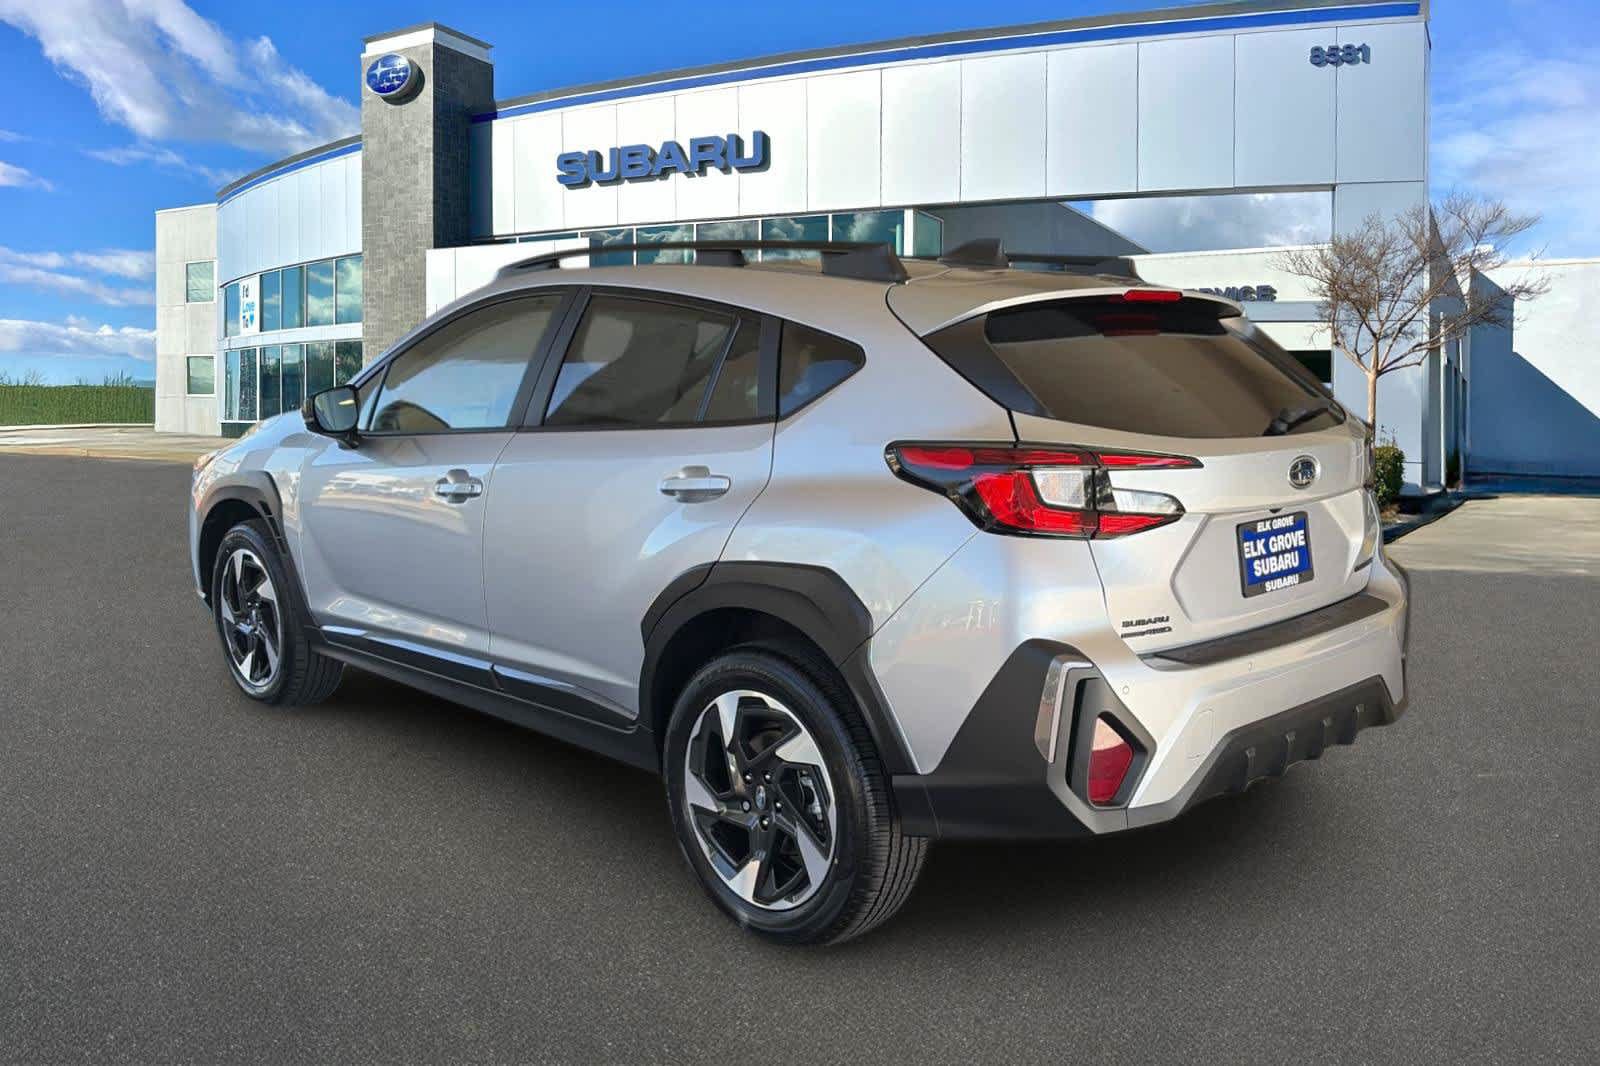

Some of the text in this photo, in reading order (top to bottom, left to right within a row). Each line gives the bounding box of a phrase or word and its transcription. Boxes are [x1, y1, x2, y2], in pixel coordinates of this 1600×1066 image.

[557, 130, 770, 189] SUBARU
[1183, 284, 1277, 301] VICE
[1257, 515, 1294, 533] ELK GROVE
[1243, 529, 1306, 559] ELK GROVE
[1253, 551, 1300, 577] SUBARU
[1265, 573, 1299, 592] SUBARU
[1121, 615, 1170, 628] SUBARU
